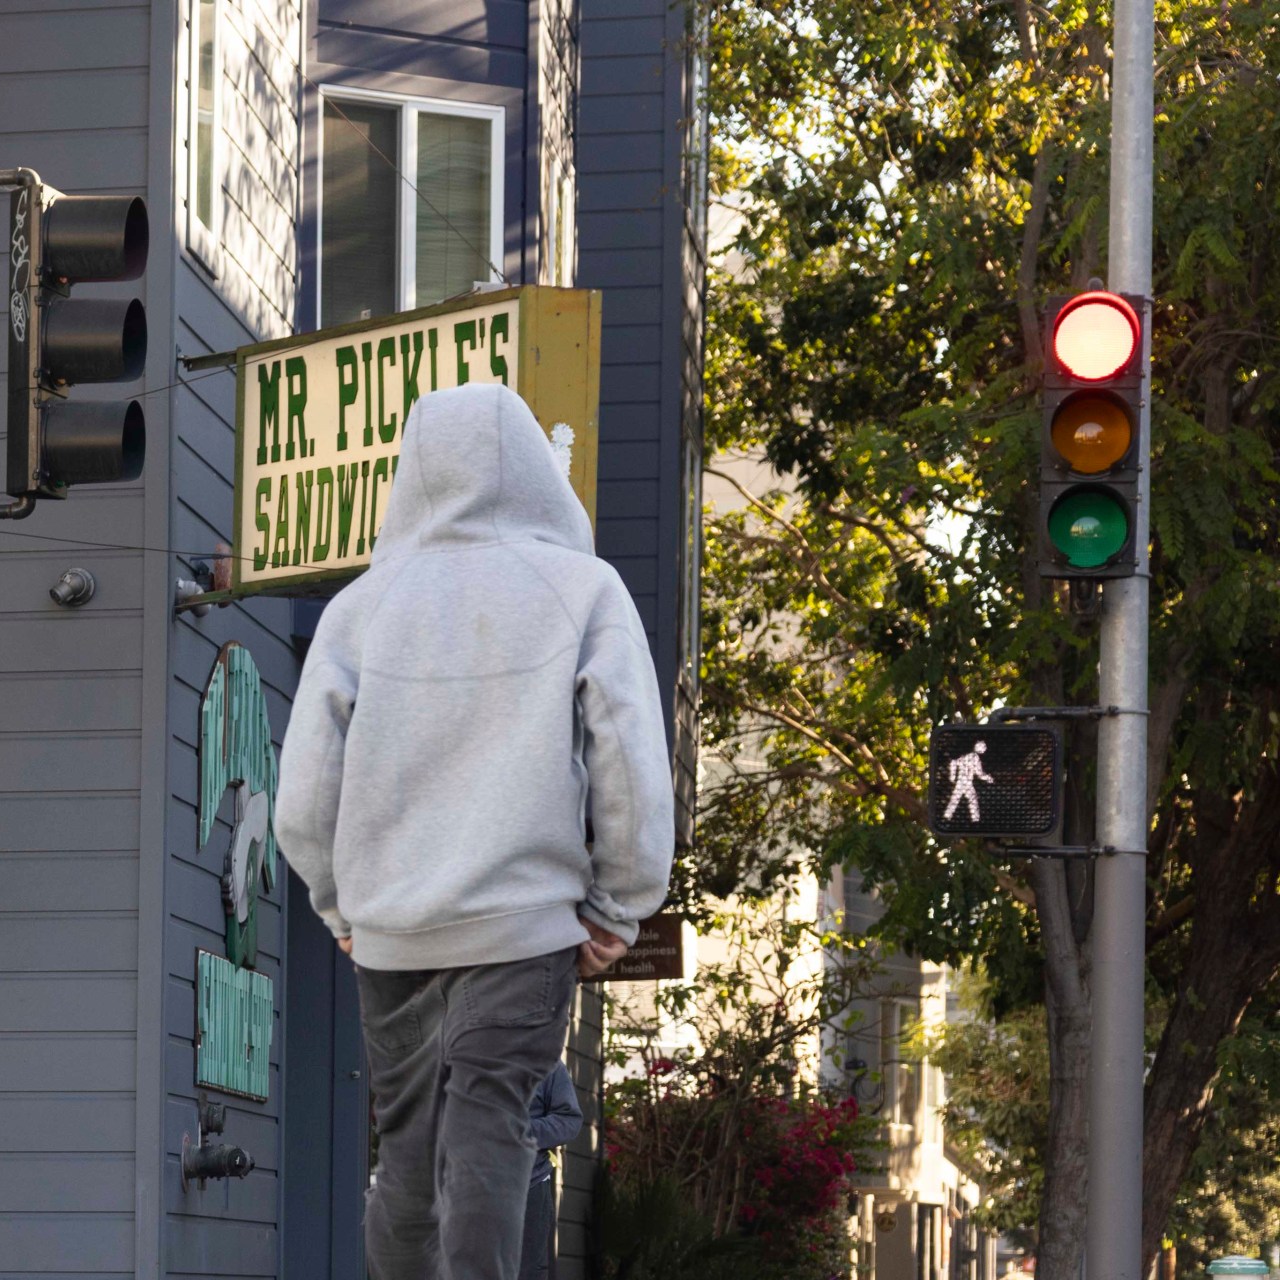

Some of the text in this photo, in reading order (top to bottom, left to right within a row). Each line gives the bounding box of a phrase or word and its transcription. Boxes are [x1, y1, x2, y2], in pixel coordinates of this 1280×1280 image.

[257, 356, 315, 466] MR.
[253, 455, 400, 571] SANDWIC
[620, 961, 656, 974] health
[627, 945, 677, 958] appiness
